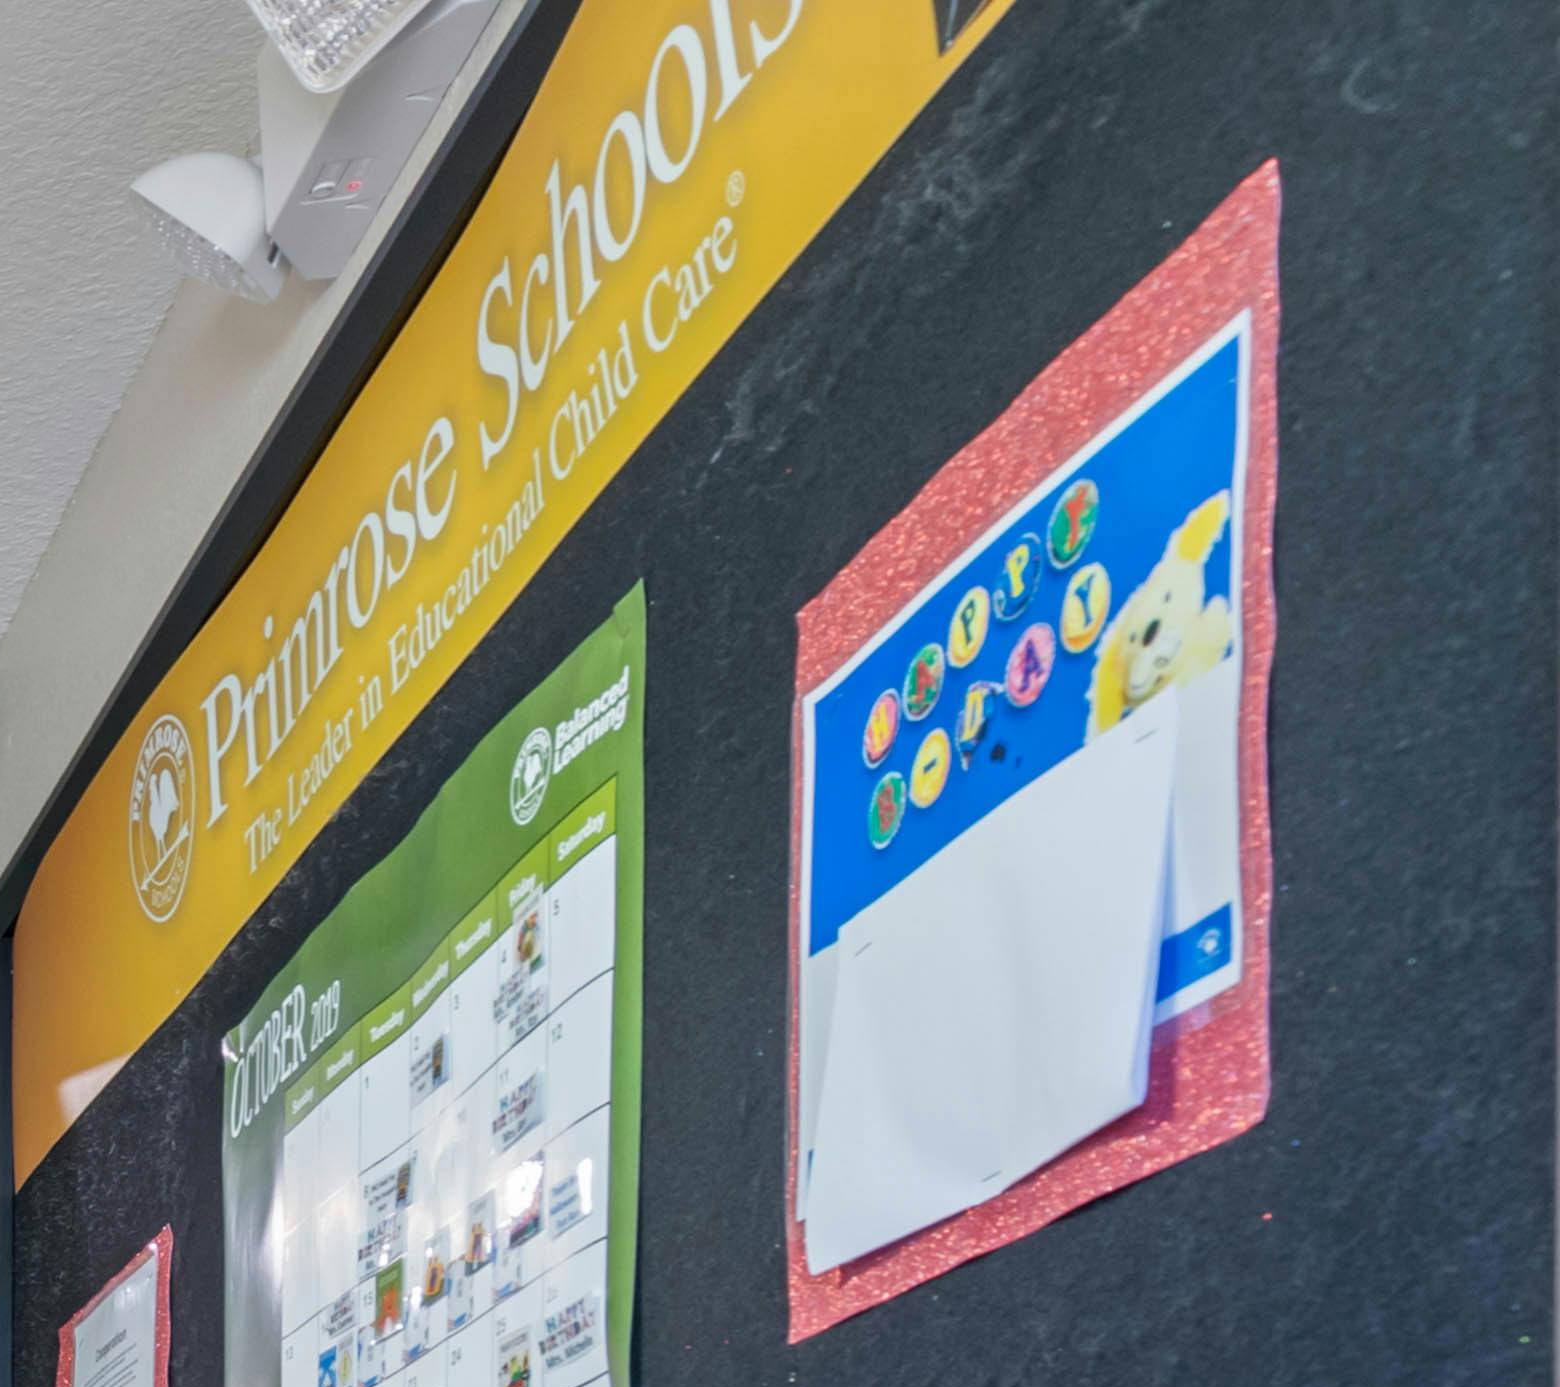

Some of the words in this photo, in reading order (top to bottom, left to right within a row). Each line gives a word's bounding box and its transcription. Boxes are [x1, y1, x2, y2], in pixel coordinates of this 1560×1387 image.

[201, 416, 457, 829] Primrose
[244, 806, 283, 876] The
[287, 708, 354, 827] Leader
[359, 673, 383, 733] in
[387, 448, 545, 695] Educational
[548, 320, 639, 481] Child
[553, 693, 629, 775] Learning
[555, 665, 629, 749] Balanced
[231, 984, 307, 1138] OCTOBER
[310, 980, 341, 1051] 2019
